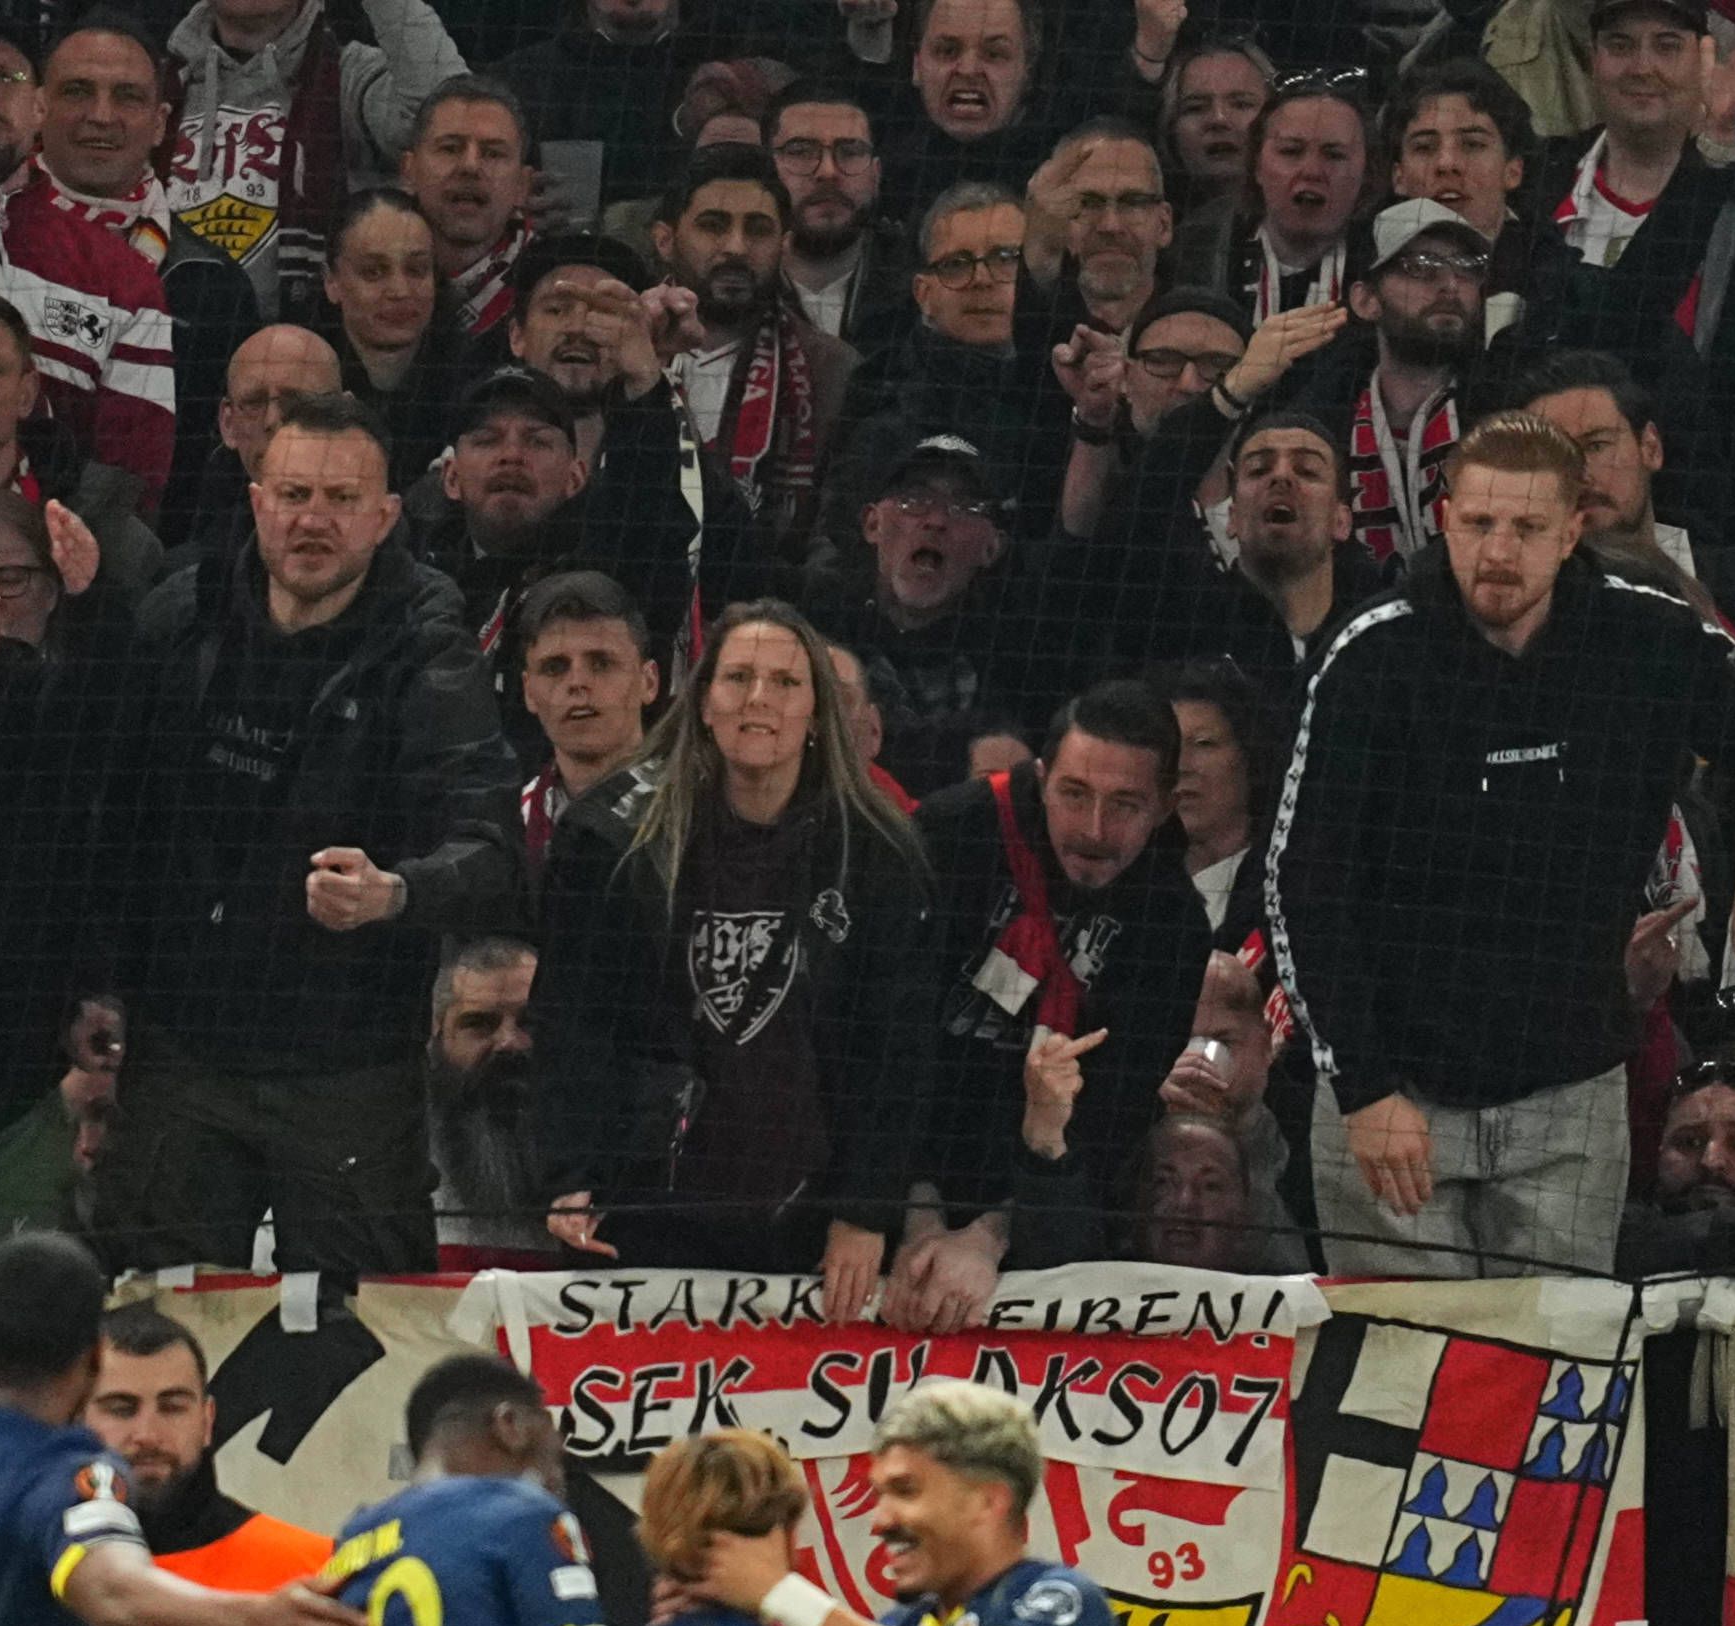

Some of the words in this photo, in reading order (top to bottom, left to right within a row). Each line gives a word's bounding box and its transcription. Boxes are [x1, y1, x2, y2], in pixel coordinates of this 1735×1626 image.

[246, 182, 266, 197] 93
[549, 1278, 828, 1335] STARK
[1146, 1541, 1207, 1591] 93
